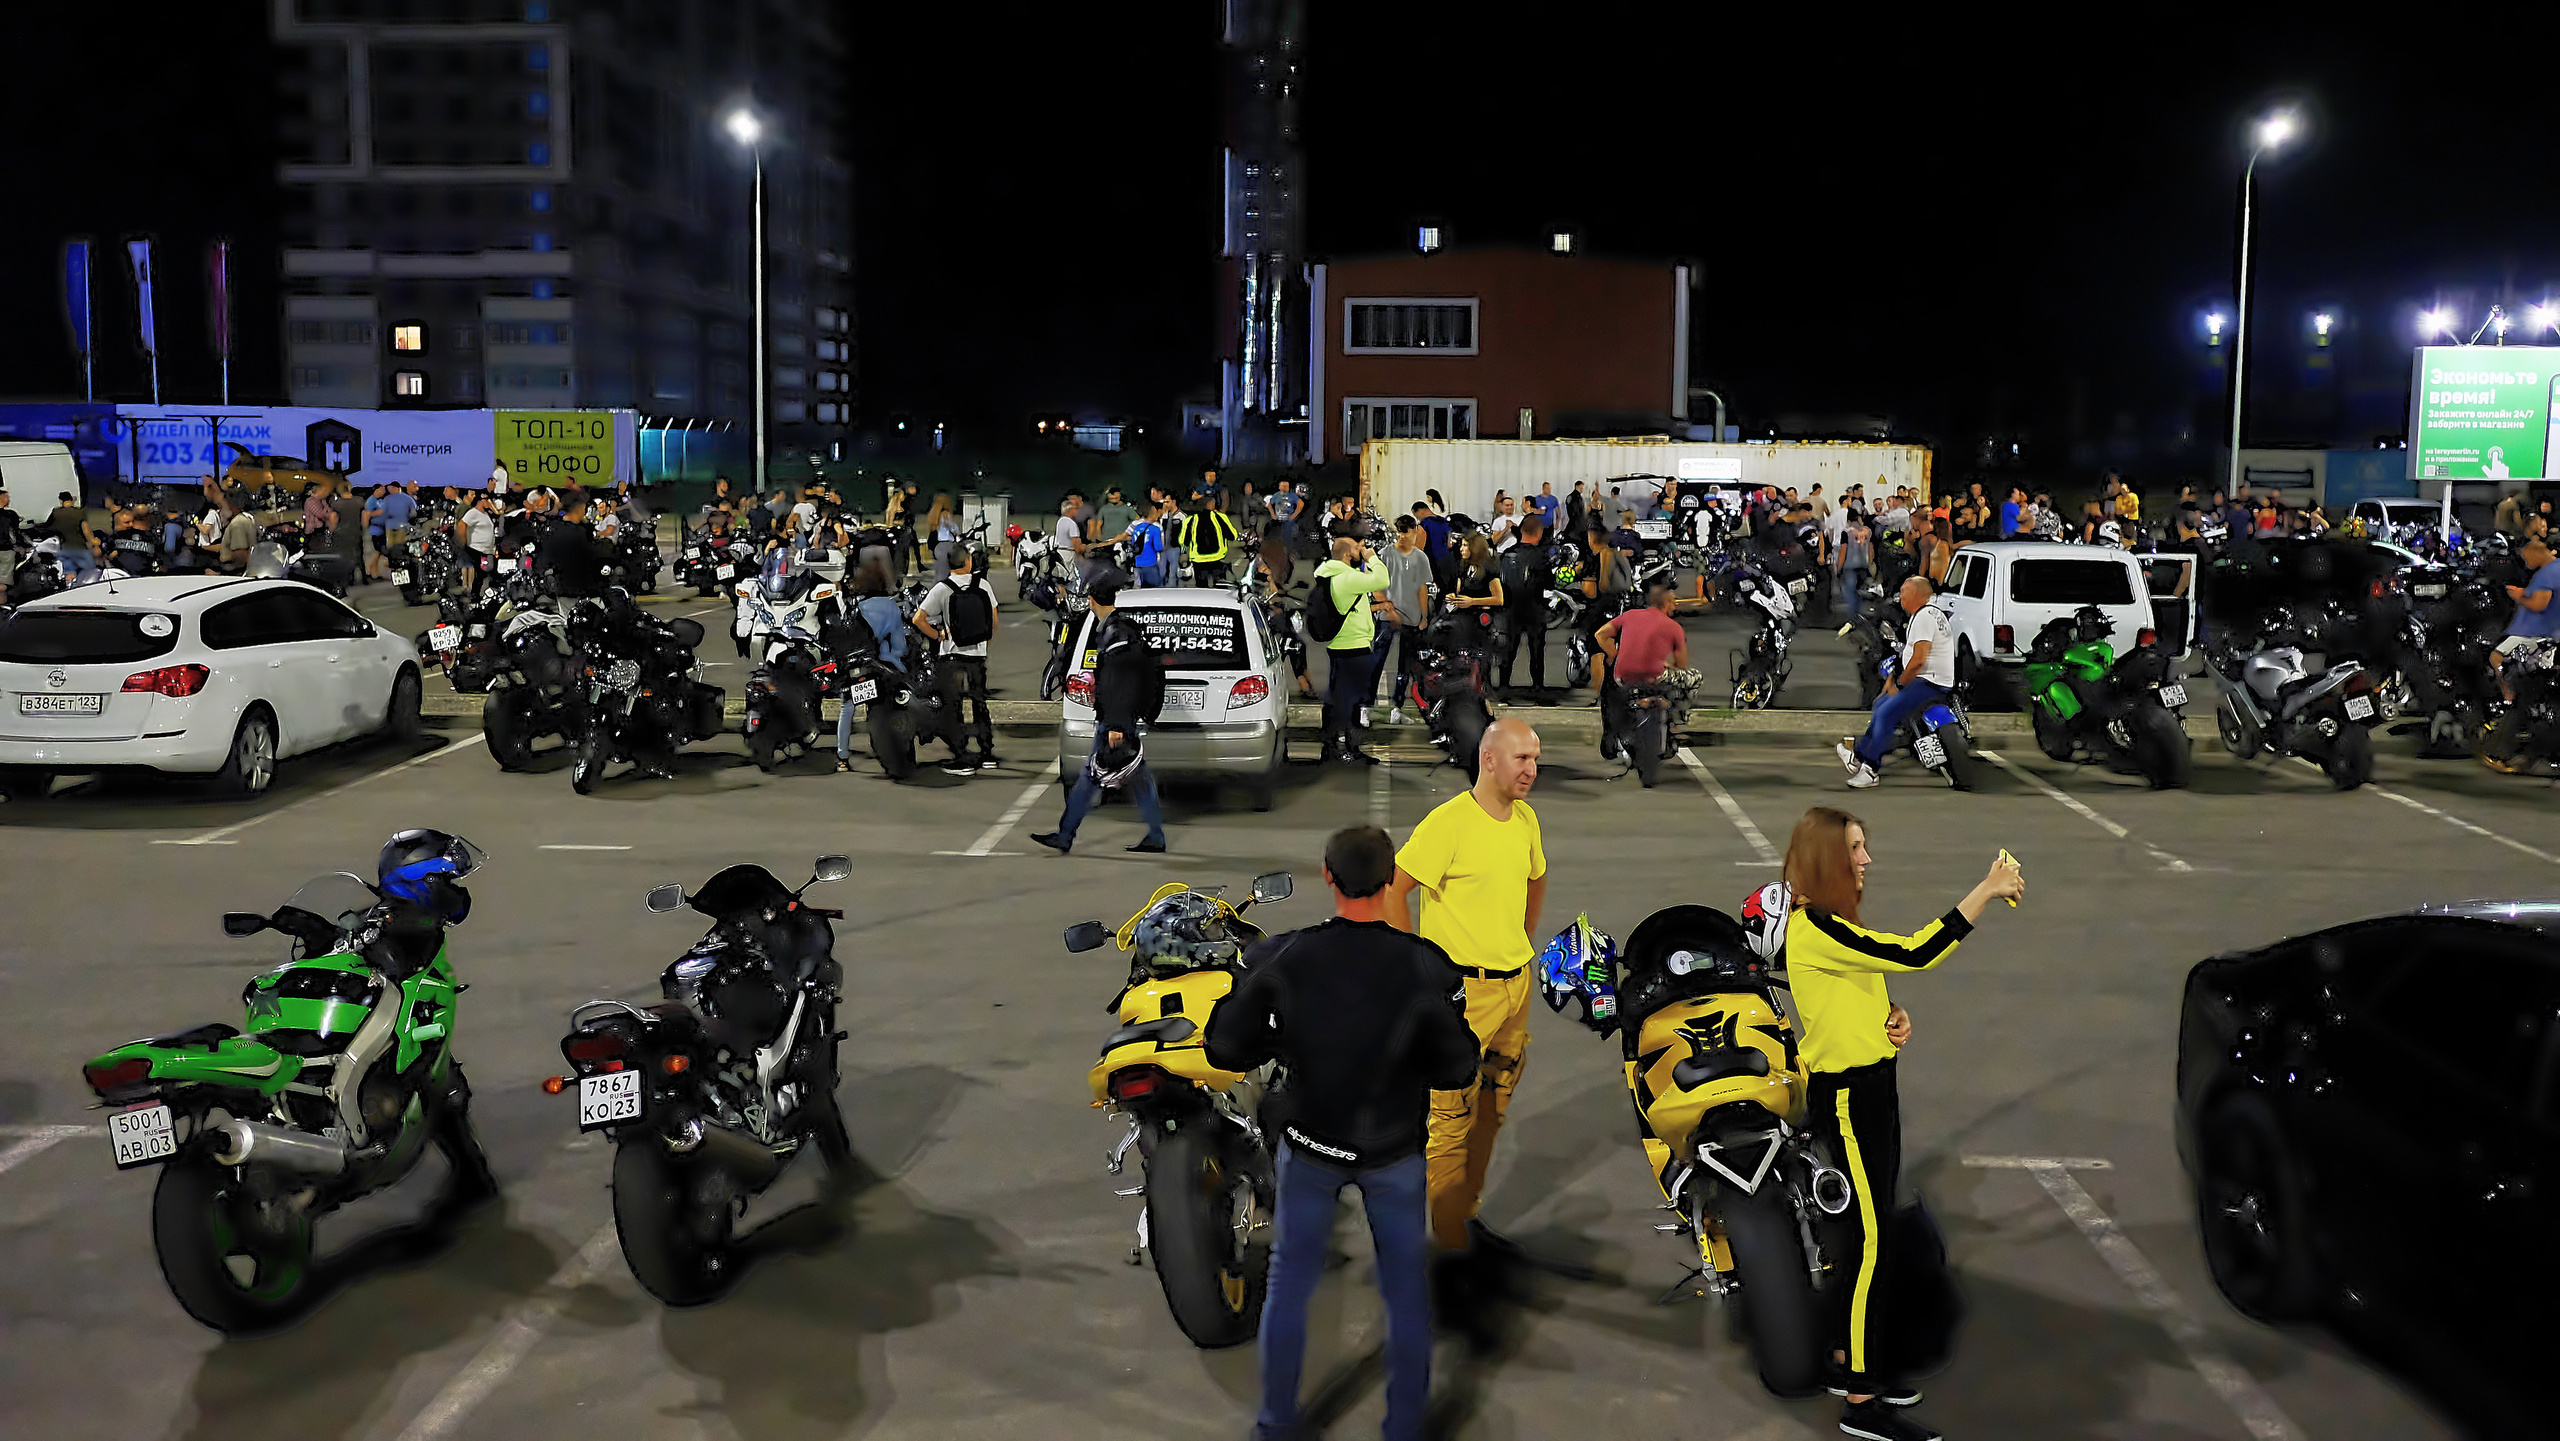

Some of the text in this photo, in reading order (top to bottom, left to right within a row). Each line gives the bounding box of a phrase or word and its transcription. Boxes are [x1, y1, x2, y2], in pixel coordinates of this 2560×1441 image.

[2430, 368, 2538, 385] Экономьте
[2429, 388, 2496, 408] время!
[2513, 409, 2535, 419] 24/7
[511, 420, 605, 439] ТОП-10
[145, 442, 194, 465] 203
[373, 441, 452, 457] Неометрия
[516, 455, 600, 474] в ЮФО
[1146, 625, 1233, 637] ПЕРГА, ПРОПОЛИС
[78, 696, 97, 706] 123
[1182, 691, 1201, 702] 123
[588, 1075, 632, 1096] 7867
[615, 1099, 635, 1116] 23
[118, 1110, 162, 1133] 5001
[144, 1129, 160, 1137] RUS
[150, 1136, 171, 1154] 03
